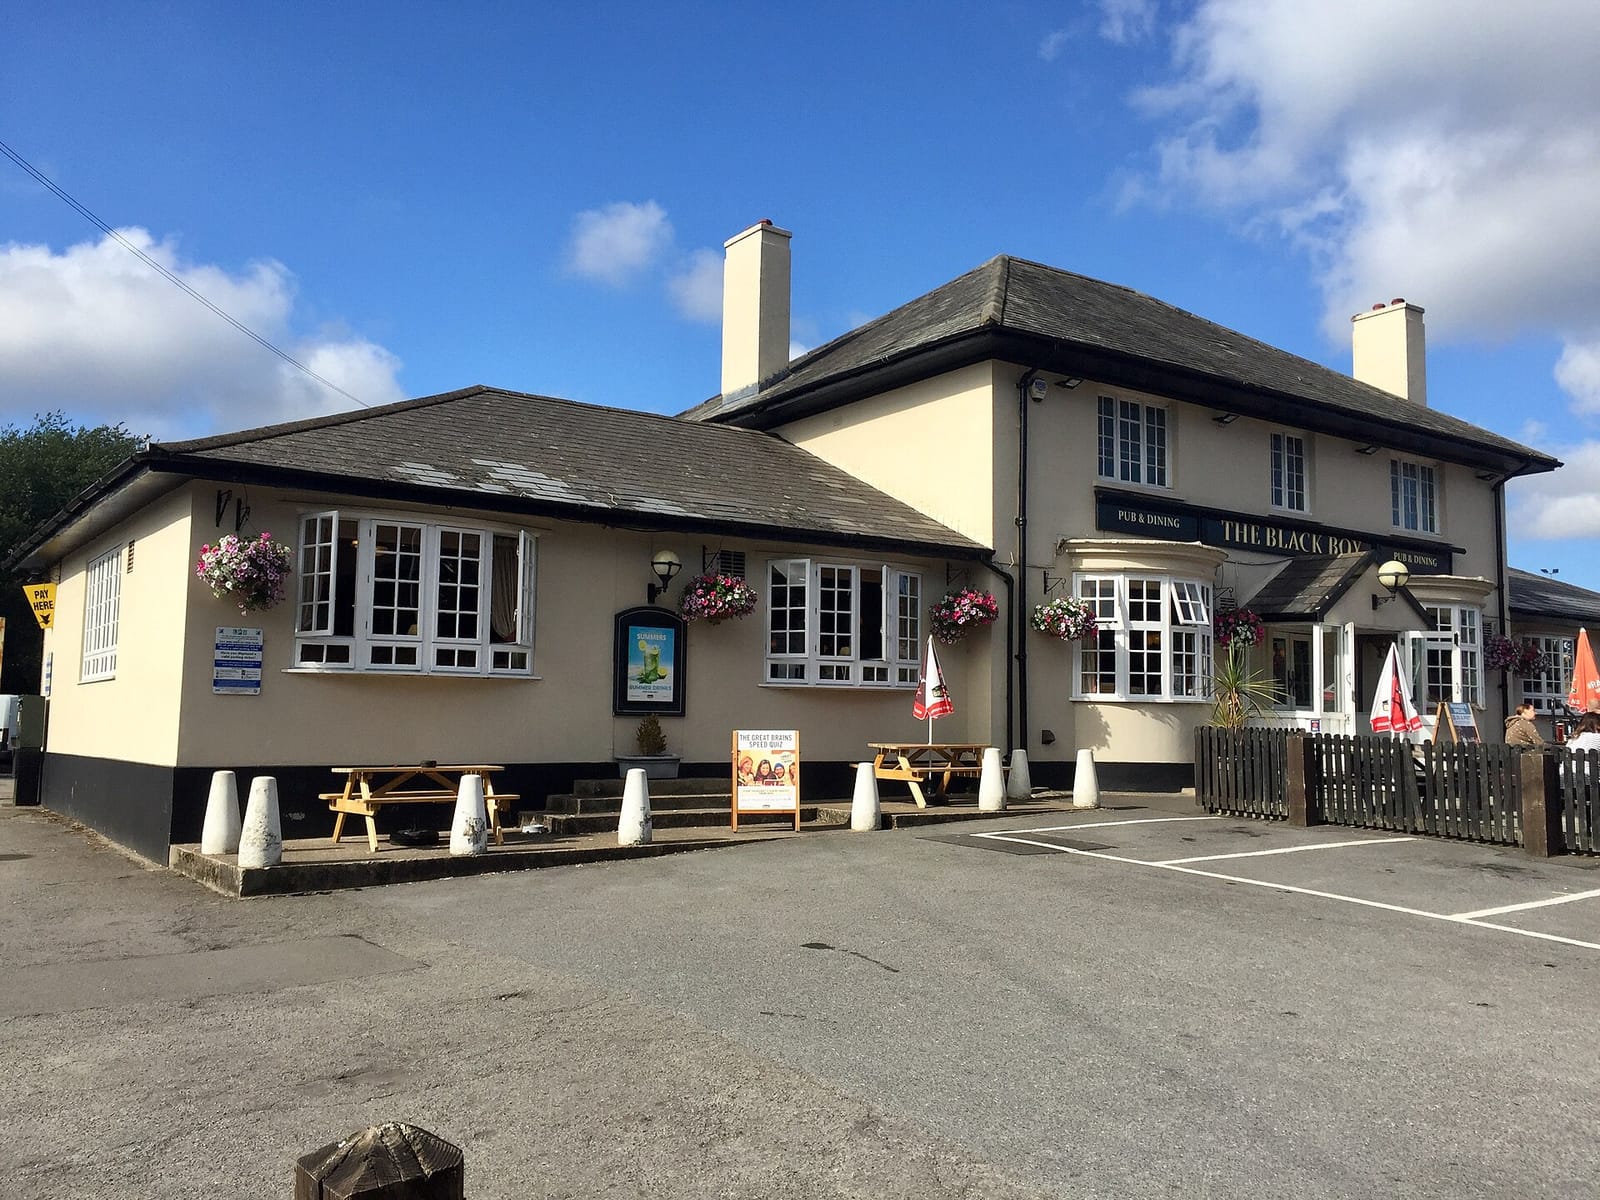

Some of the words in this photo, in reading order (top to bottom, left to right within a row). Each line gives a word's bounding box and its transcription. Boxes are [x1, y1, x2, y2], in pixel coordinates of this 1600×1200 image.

[1118, 510, 1137, 522] PUB
[1138, 513, 1145, 524] &
[1147, 514, 1180, 528] DINING
[1221, 520, 1260, 545] THE
[1266, 526, 1322, 554] BLACK
[1393, 551, 1407, 562] PUB
[1413, 555, 1438, 567] DINING
[34, 589, 48, 599] PAY
[33, 600, 54, 611] HERE
